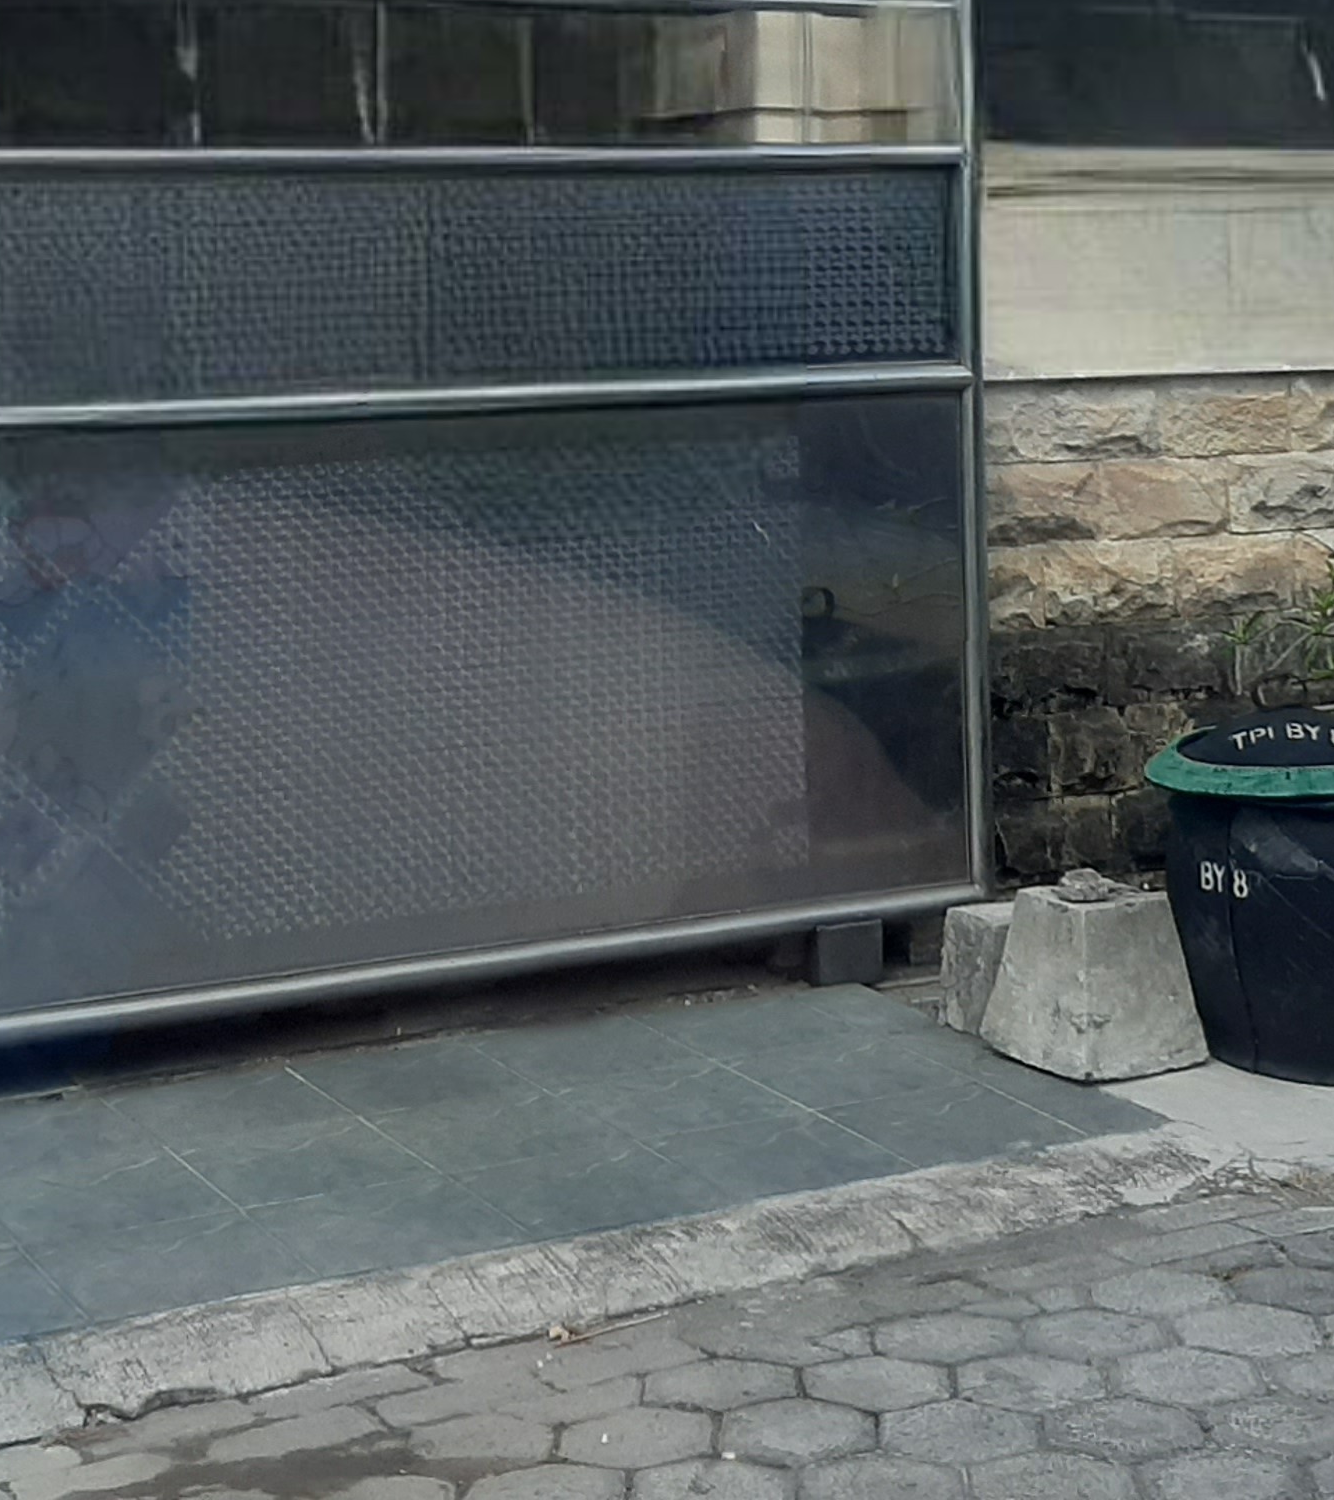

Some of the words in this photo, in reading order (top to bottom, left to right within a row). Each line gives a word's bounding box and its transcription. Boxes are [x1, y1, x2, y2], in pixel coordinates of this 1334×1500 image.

[1230, 726, 1274, 750] TPI
[1286, 723, 1320, 740] BY
[1200, 860, 1226, 893] BY
[1232, 869, 1249, 898] 8
